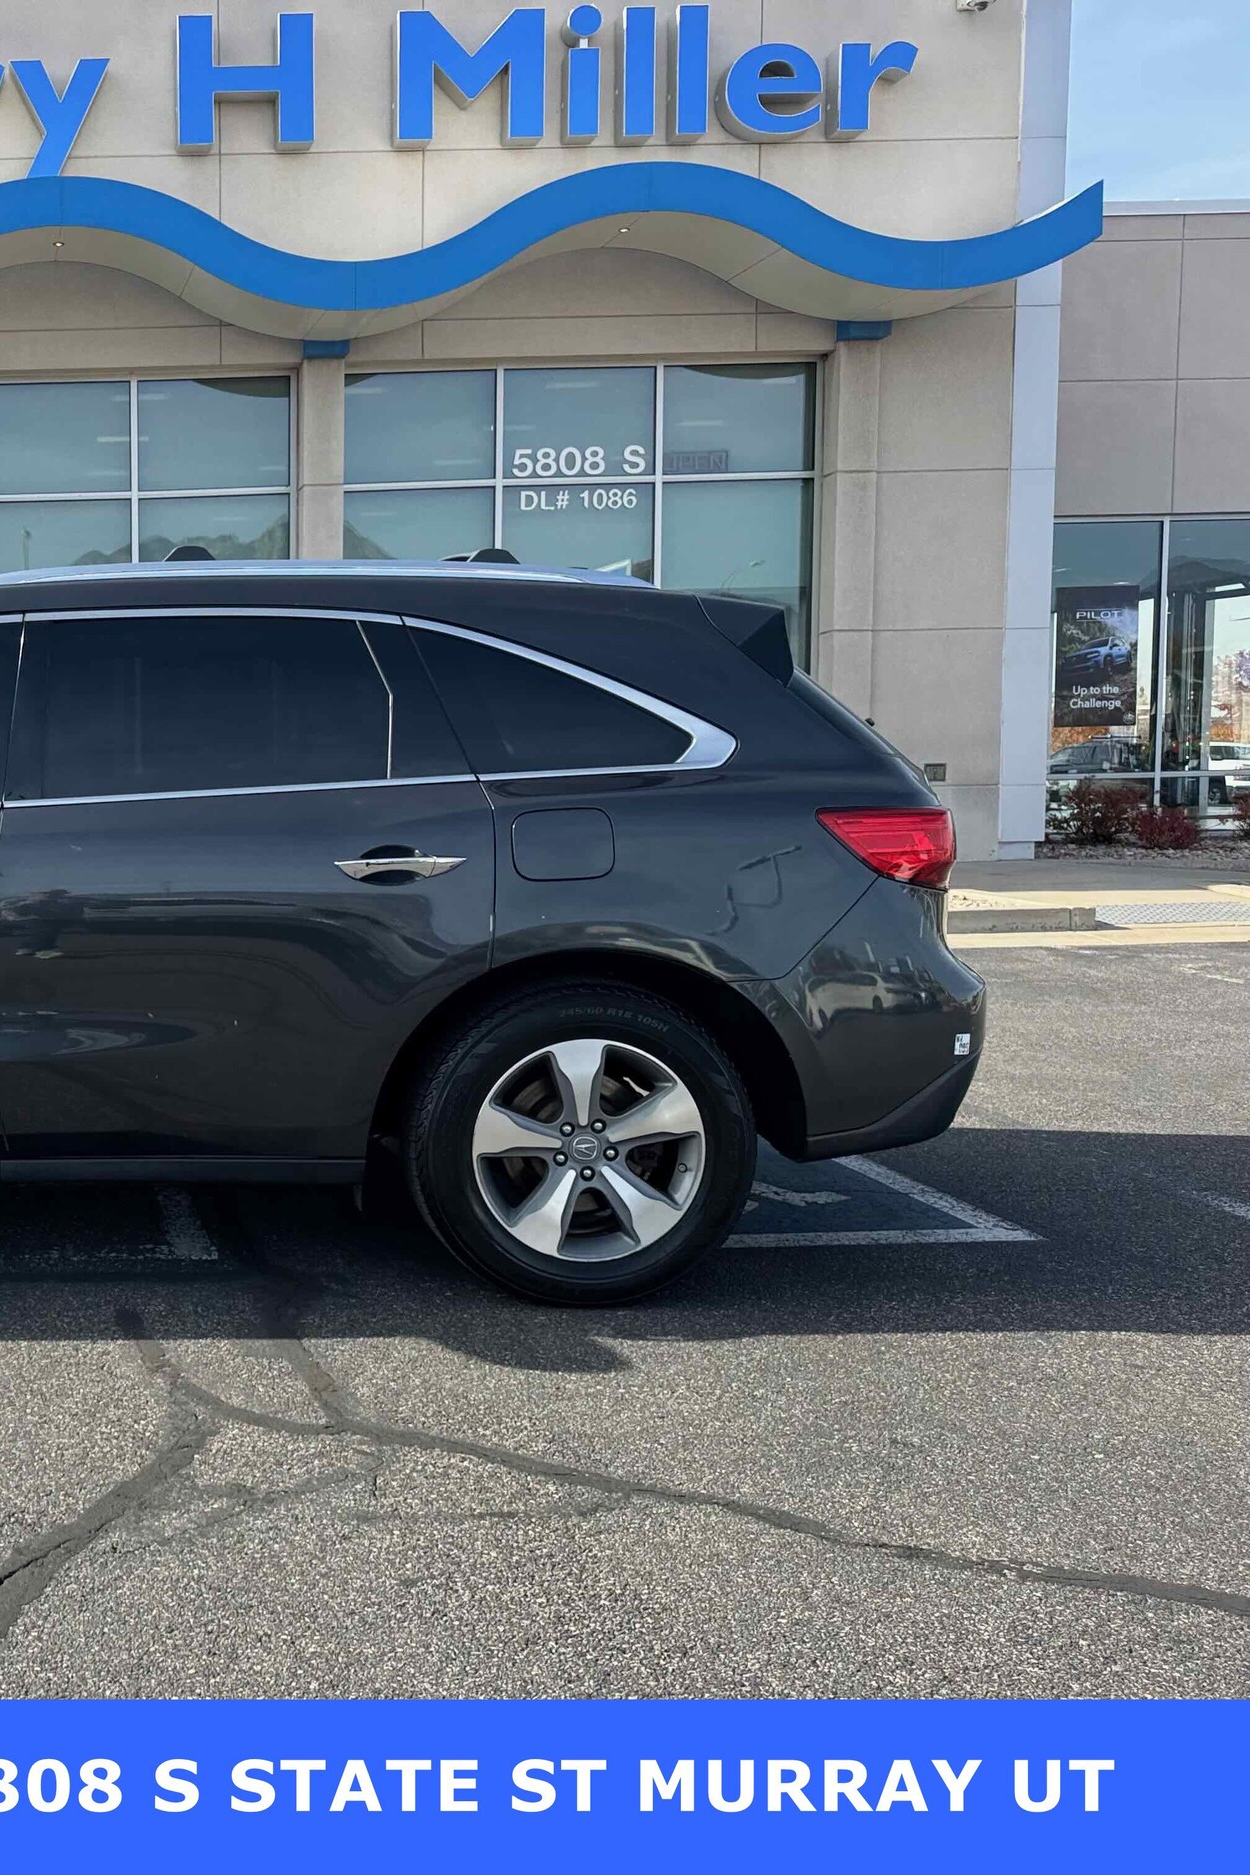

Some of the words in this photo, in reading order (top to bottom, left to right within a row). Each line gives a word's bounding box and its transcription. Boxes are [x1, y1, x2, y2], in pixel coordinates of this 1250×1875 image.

[177, 13, 315, 150] H
[393, 4, 919, 147] Miller
[511, 446, 605, 477] 5808
[622, 445, 646, 474] S
[519, 490, 569, 511] DL#
[579, 488, 637, 509] 1086
[1076, 610, 1123, 619] PILOT
[1072, 685, 1088, 697] Up
[1090, 686, 1100, 695] to
[1102, 684, 1120, 694] the
[1069, 698, 1122, 710] Challenge
